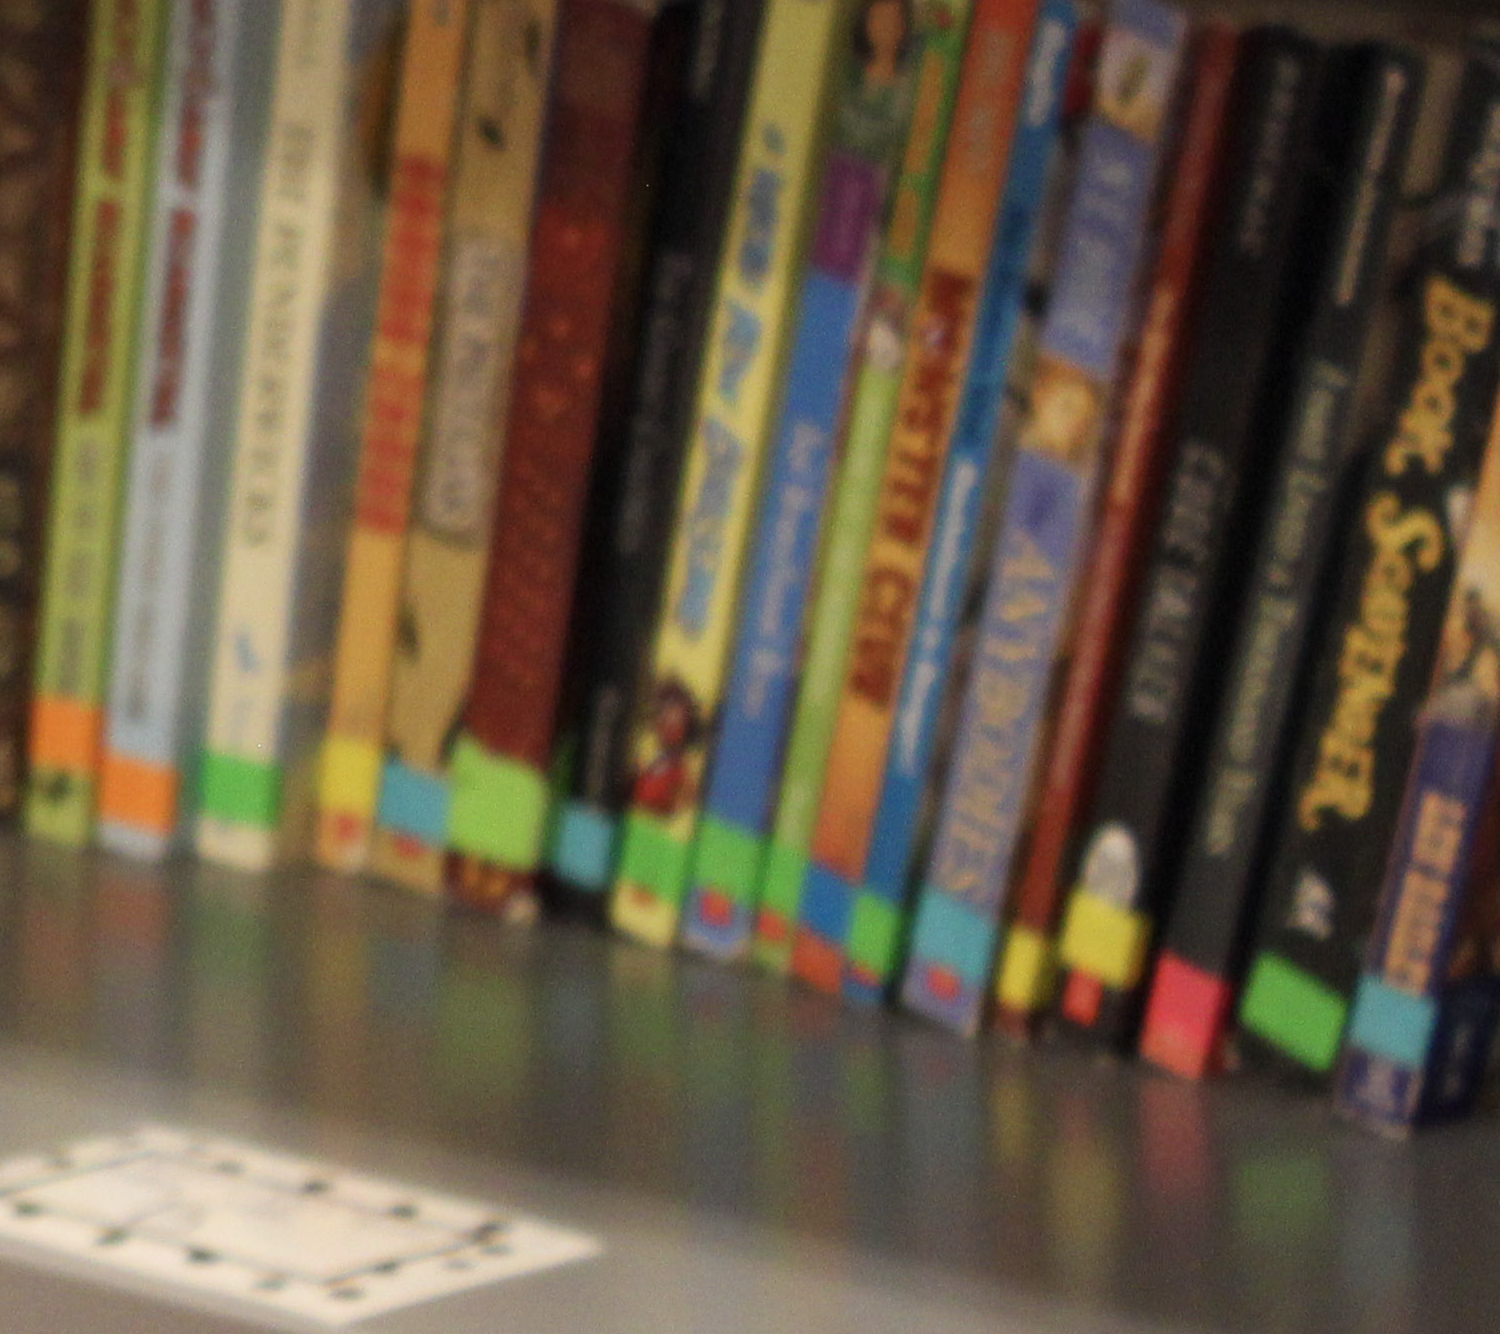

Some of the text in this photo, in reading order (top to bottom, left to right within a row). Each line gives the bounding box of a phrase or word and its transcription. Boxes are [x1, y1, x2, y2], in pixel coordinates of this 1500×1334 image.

[877, 266, 980, 552] MONSTER
[1160, 436, 1229, 560] CODE
[1384, 275, 1494, 479] BOOK
[845, 564, 920, 709] CLUB
[933, 531, 1065, 900] ANYBODIES
[1299, 493, 1444, 833] SCAVENGER
